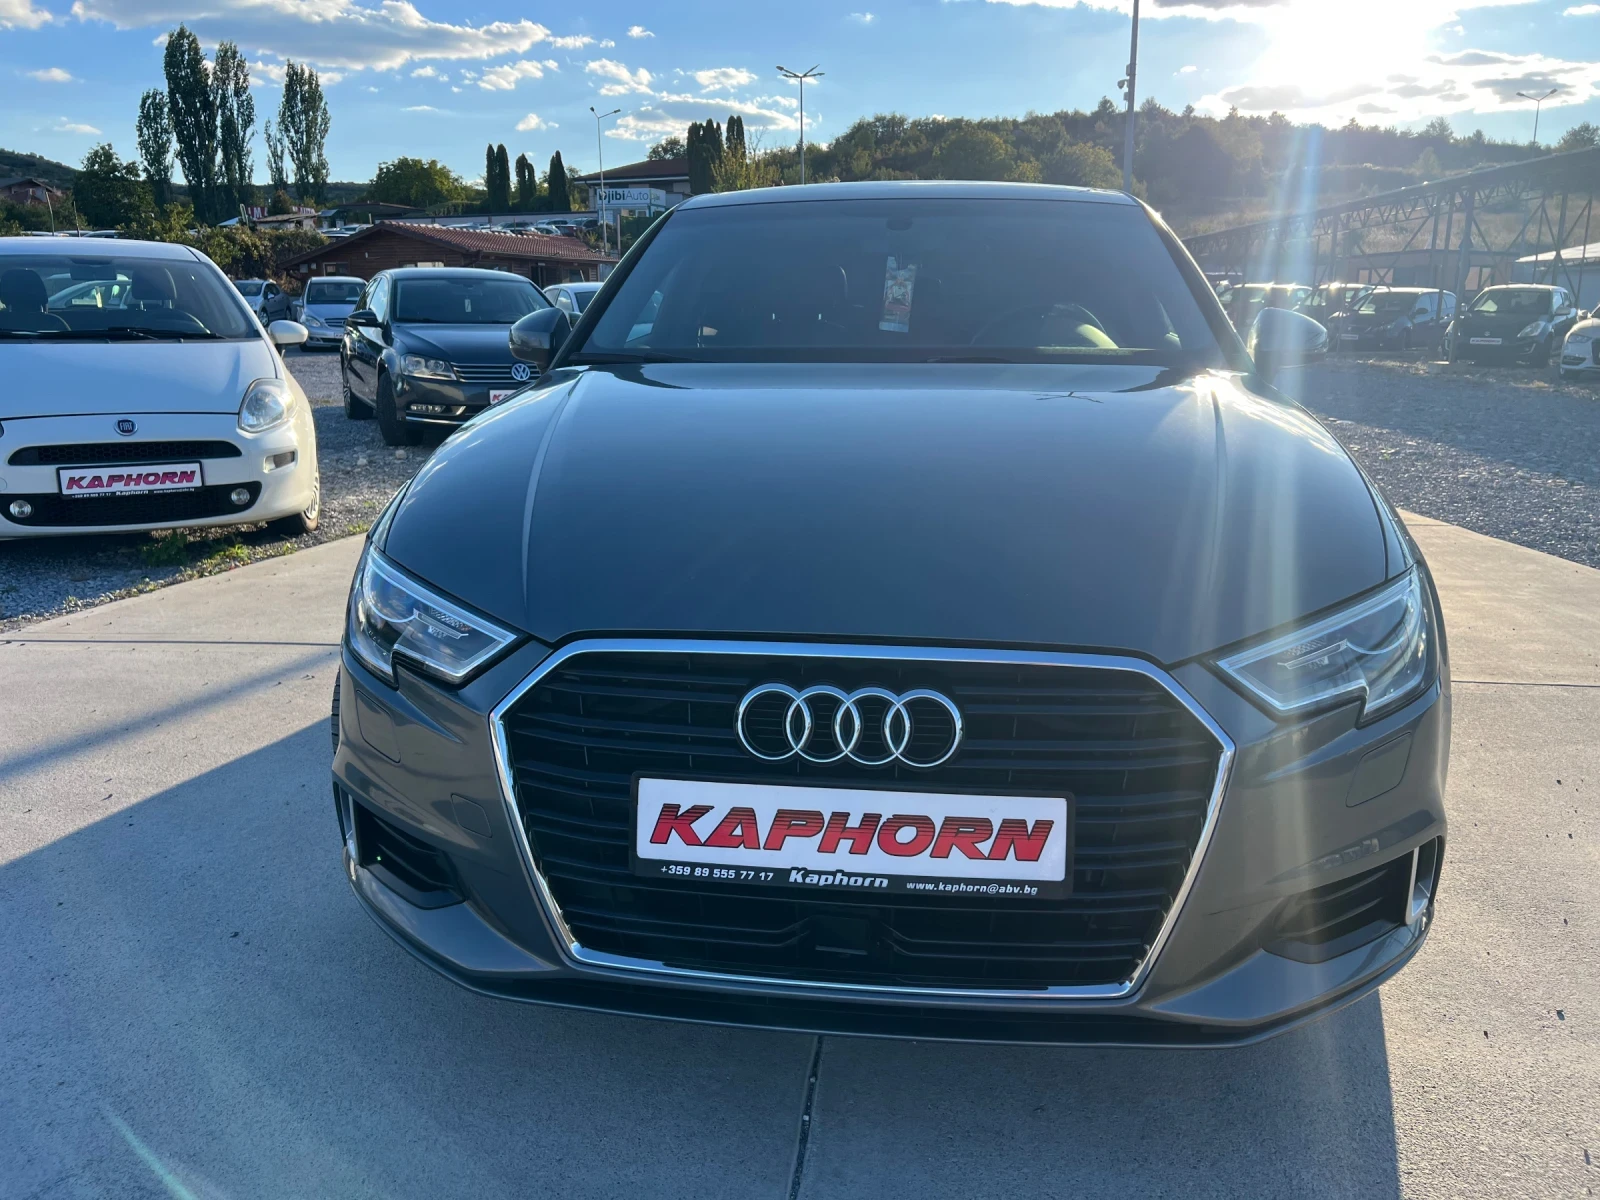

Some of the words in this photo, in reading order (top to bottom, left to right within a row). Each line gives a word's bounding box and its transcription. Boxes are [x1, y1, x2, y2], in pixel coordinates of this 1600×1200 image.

[598, 190, 649, 204] DjibiAuto
[119, 421, 133, 431] FIAT
[66, 470, 196, 490] KAPHORN
[649, 803, 1055, 862] KAPHORN
[660, 864, 691, 876] +359
[694, 866, 709, 877] 89
[712, 868, 736, 879] 555
[739, 870, 755, 880] 77
[758, 872, 774, 882] 17
[788, 869, 889, 888] Kaphorn
[906, 880, 1039, 896] www.kaphorn@abv.bg
